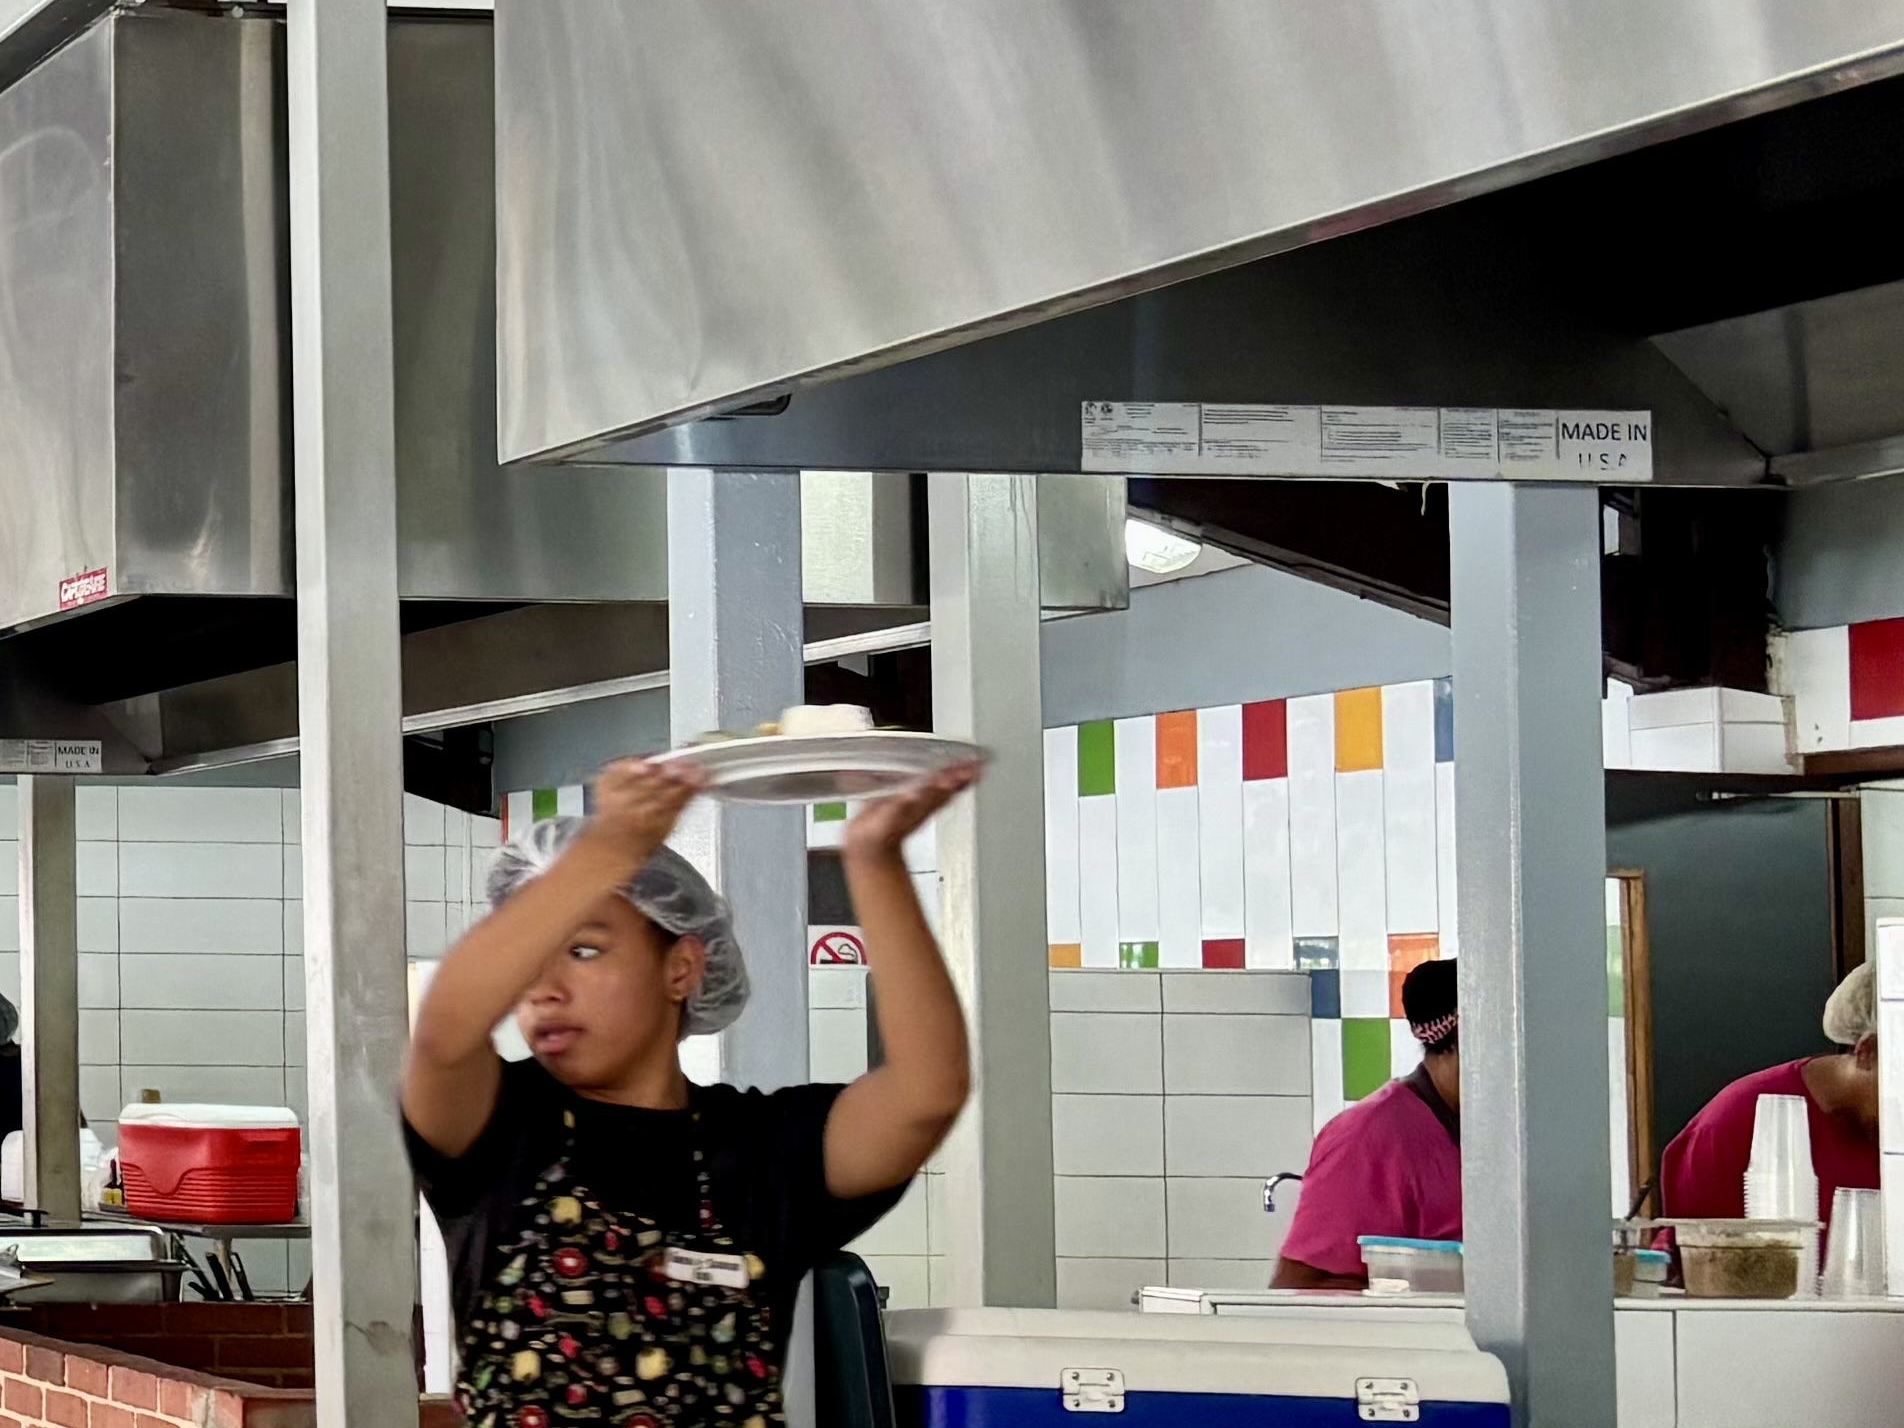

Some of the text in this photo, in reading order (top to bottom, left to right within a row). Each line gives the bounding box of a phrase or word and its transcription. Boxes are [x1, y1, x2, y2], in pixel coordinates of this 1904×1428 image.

[1561, 422, 1648, 441] MADE IN
[57, 745, 86, 756] MADE
